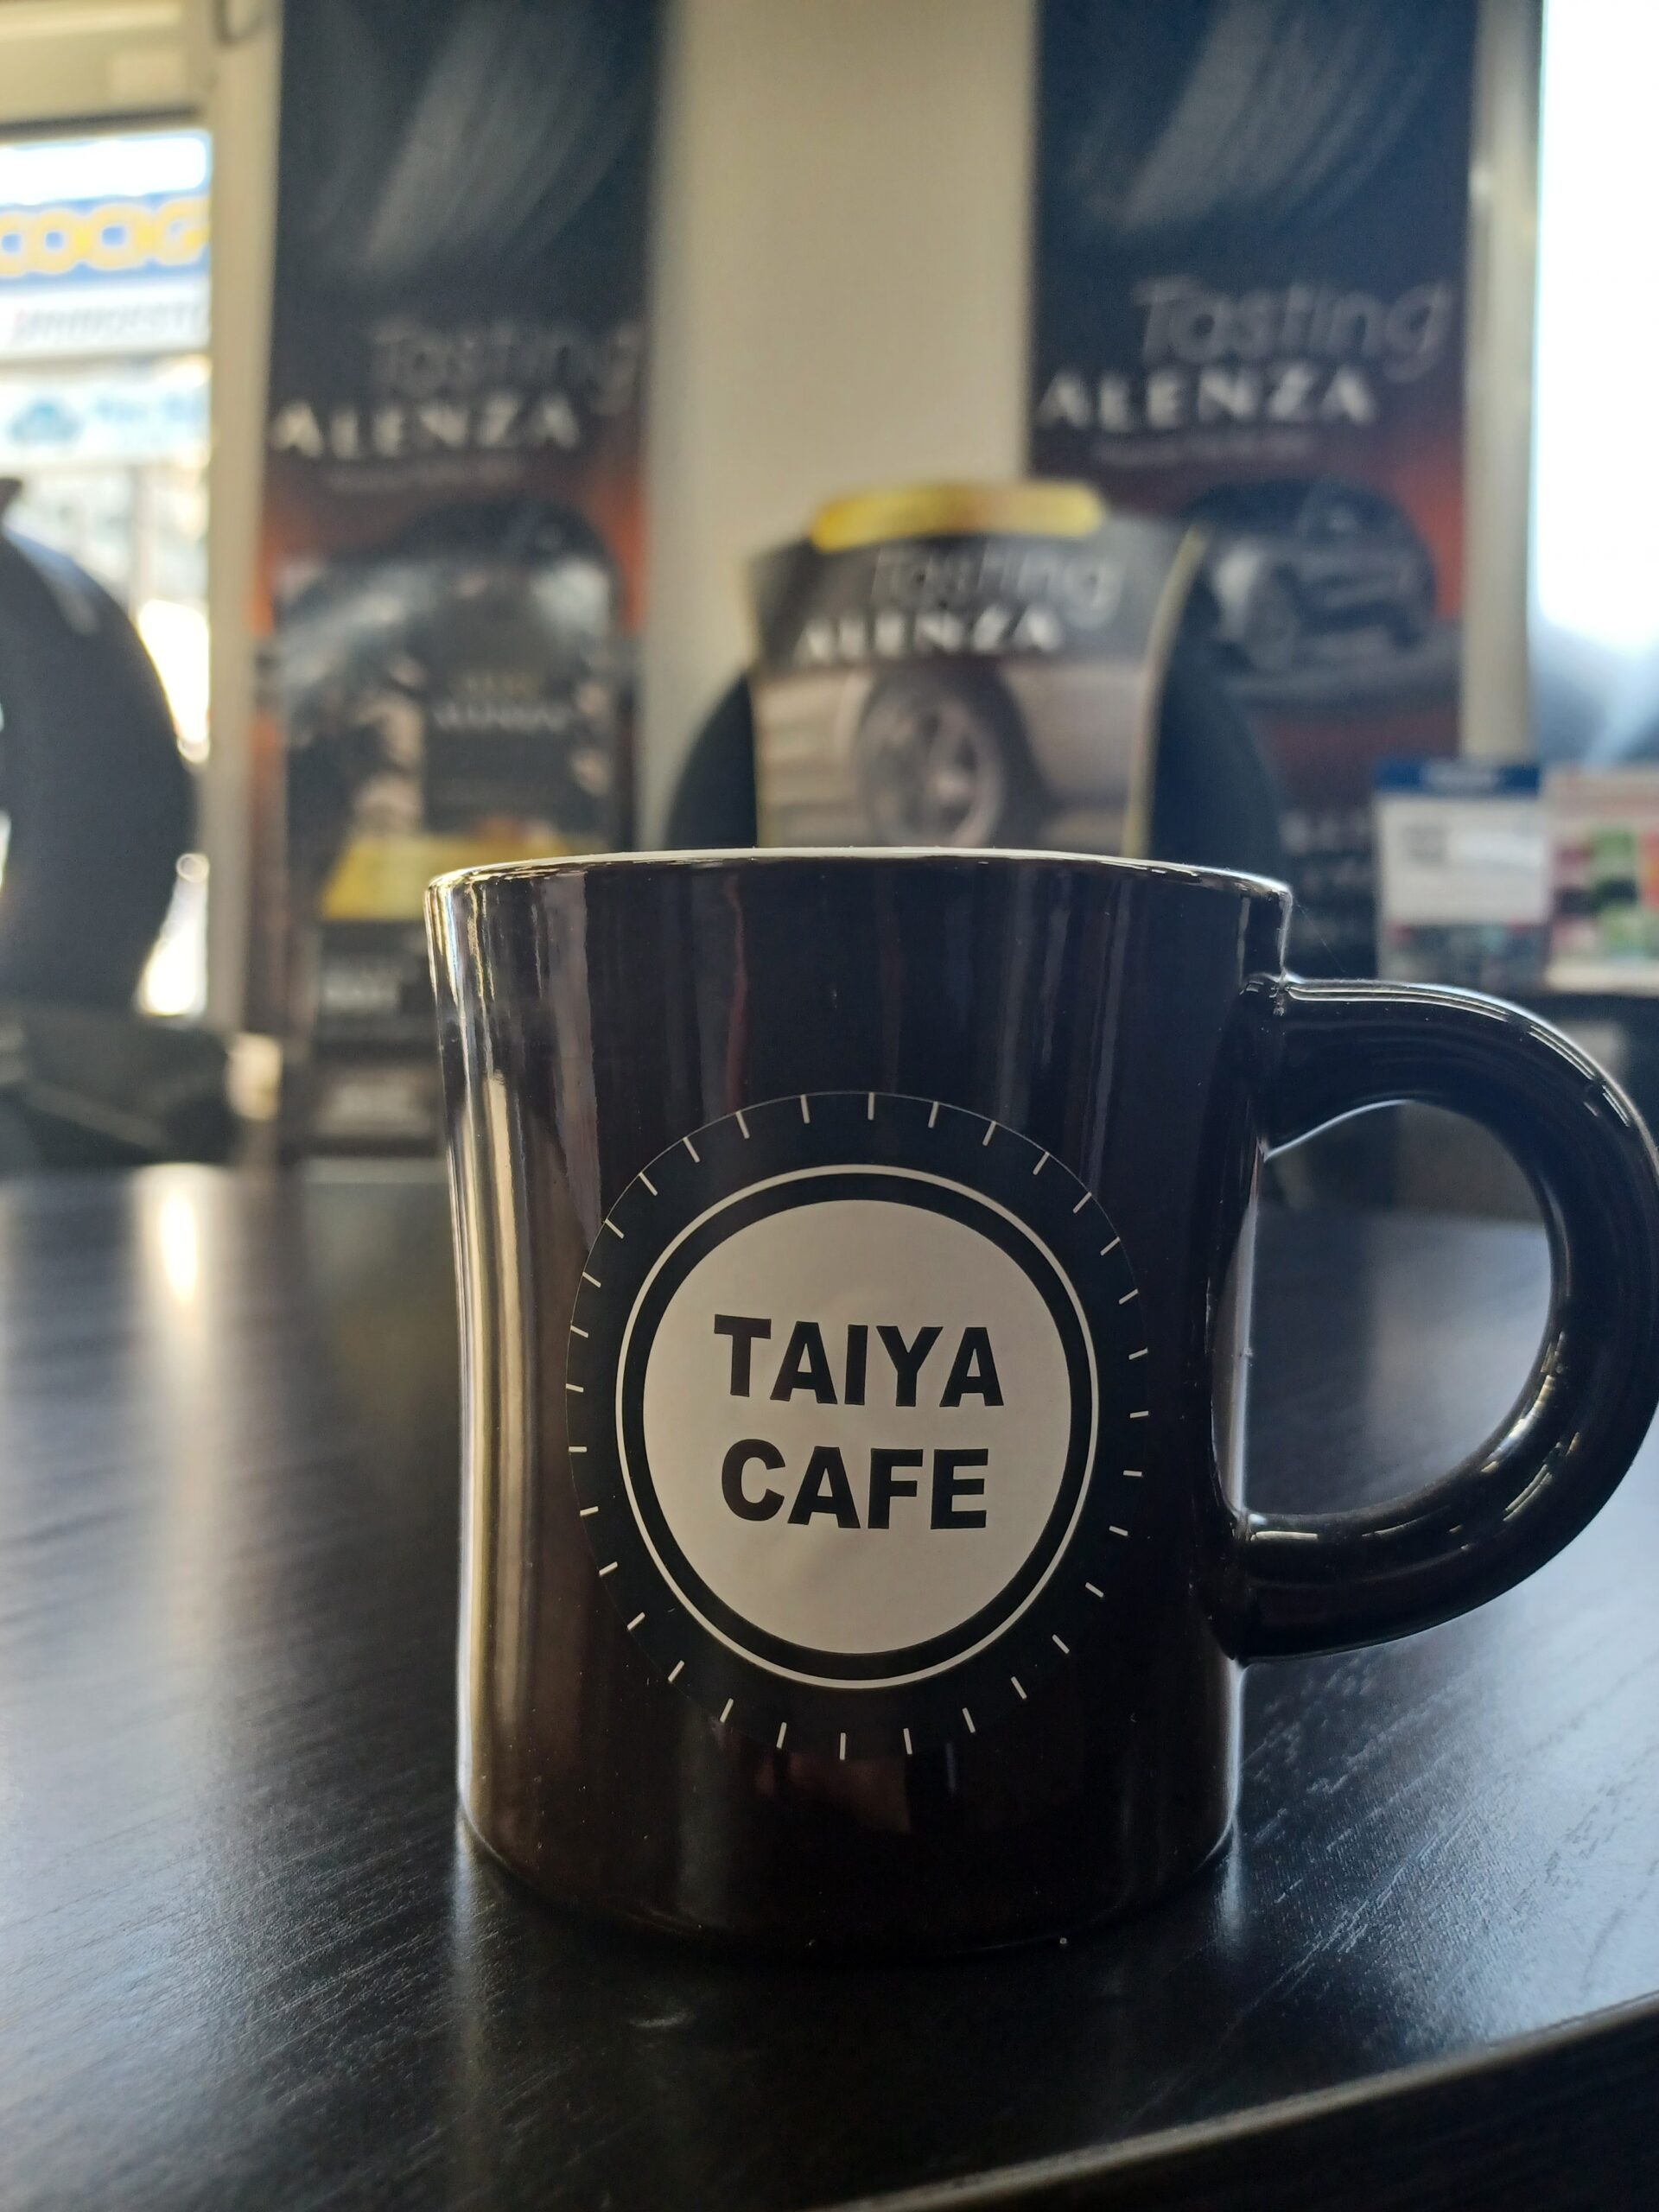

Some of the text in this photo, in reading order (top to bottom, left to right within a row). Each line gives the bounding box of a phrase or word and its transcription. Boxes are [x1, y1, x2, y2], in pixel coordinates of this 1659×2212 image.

[1133, 274, 1453, 383] Tasting
[270, 393, 581, 459] ALENZA
[1036, 362, 1376, 431] ALENZA
[793, 605, 1065, 661] ALENZA
[714, 1313, 1004, 1408] TAIYA
[721, 1438, 988, 1529] CAFE
